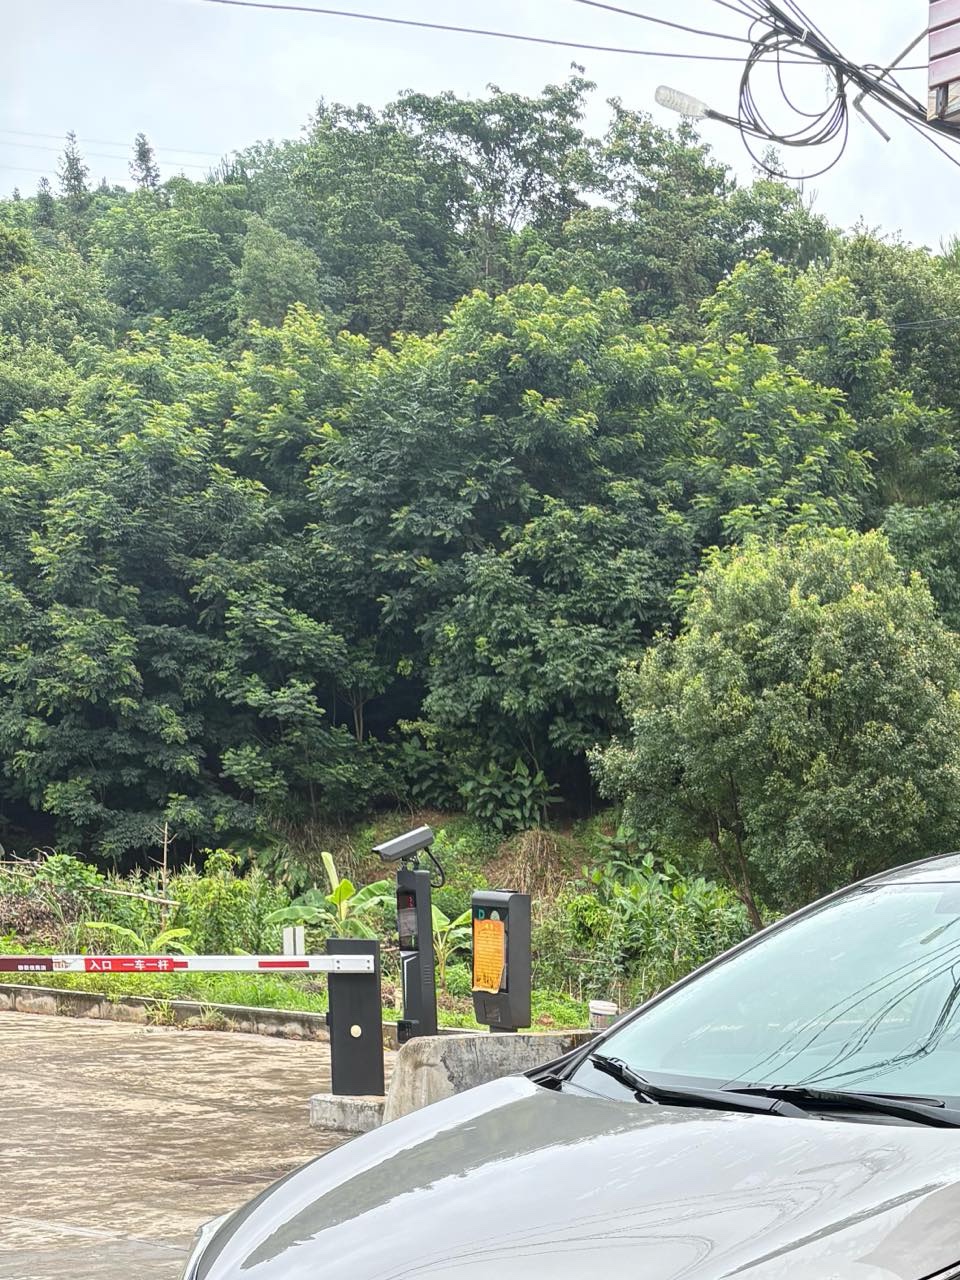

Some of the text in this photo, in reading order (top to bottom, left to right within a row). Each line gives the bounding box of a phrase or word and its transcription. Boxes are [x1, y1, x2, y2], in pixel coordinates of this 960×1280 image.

[90, 959, 169, 970] 入口 一车一杆
